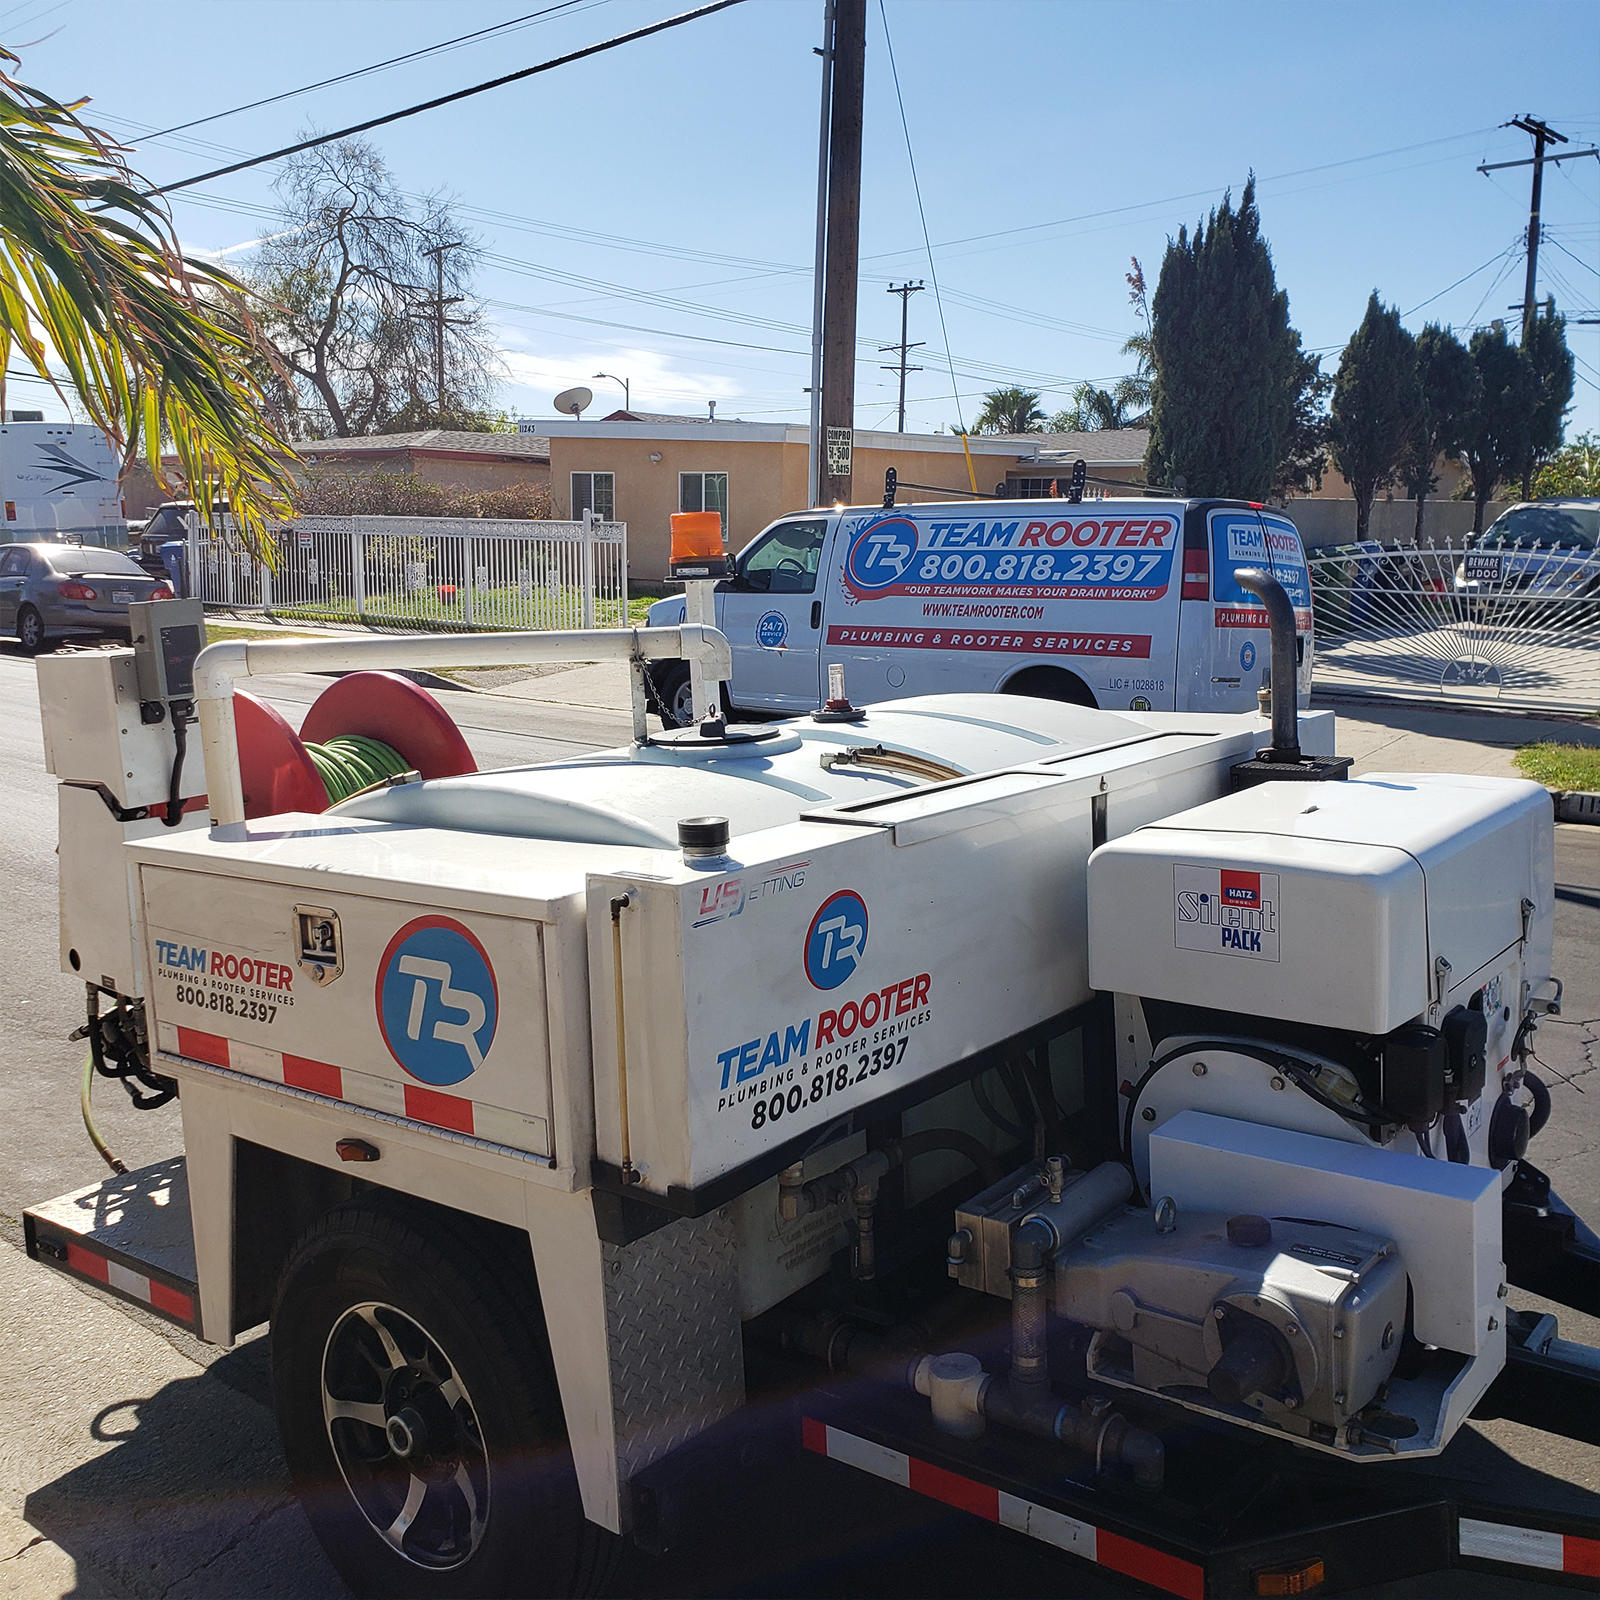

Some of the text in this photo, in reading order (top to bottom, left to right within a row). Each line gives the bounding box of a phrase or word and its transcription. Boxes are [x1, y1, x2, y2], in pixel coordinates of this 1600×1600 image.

[927, 520, 1172, 548] TEAM ROOTER
[1231, 528, 1263, 548] TEAM
[919, 554, 1162, 582] 800.818.2397
[1467, 569, 1498, 578] of DOG
[1468, 556, 1499, 568] BEWARE
[933, 587, 992, 596] TEAMWORK
[995, 587, 1033, 597] MAKES
[1036, 588, 1067, 597] YOUR
[1070, 589, 1108, 598] DRAIN
[922, 603, 1044, 620] WWW.TEAMROOTER.COM
[1221, 612, 1257, 624] PLUMBING
[762, 621, 783, 632] 24/7
[840, 630, 1133, 652] PLUMBING & ROOTER SERVICES
[1109, 678, 1122, 689] LIC
[1132, 680, 1165, 692] 1028818
[1229, 888, 1253, 900] HATZ
[1177, 891, 1276, 933] Silent
[1221, 927, 1261, 952] PACK
[156, 939, 294, 992] TEAM ROOTER
[158, 968, 295, 1007] PLUMBING & ROOTER SERVICES
[176, 984, 278, 1025] 800.818.2397
[716, 972, 932, 1091] TEAM ROOTER
[717, 1009, 932, 1113] PLUMBING & ROOTER SERVICES
[750, 1035, 910, 1131] 800.818.2397
